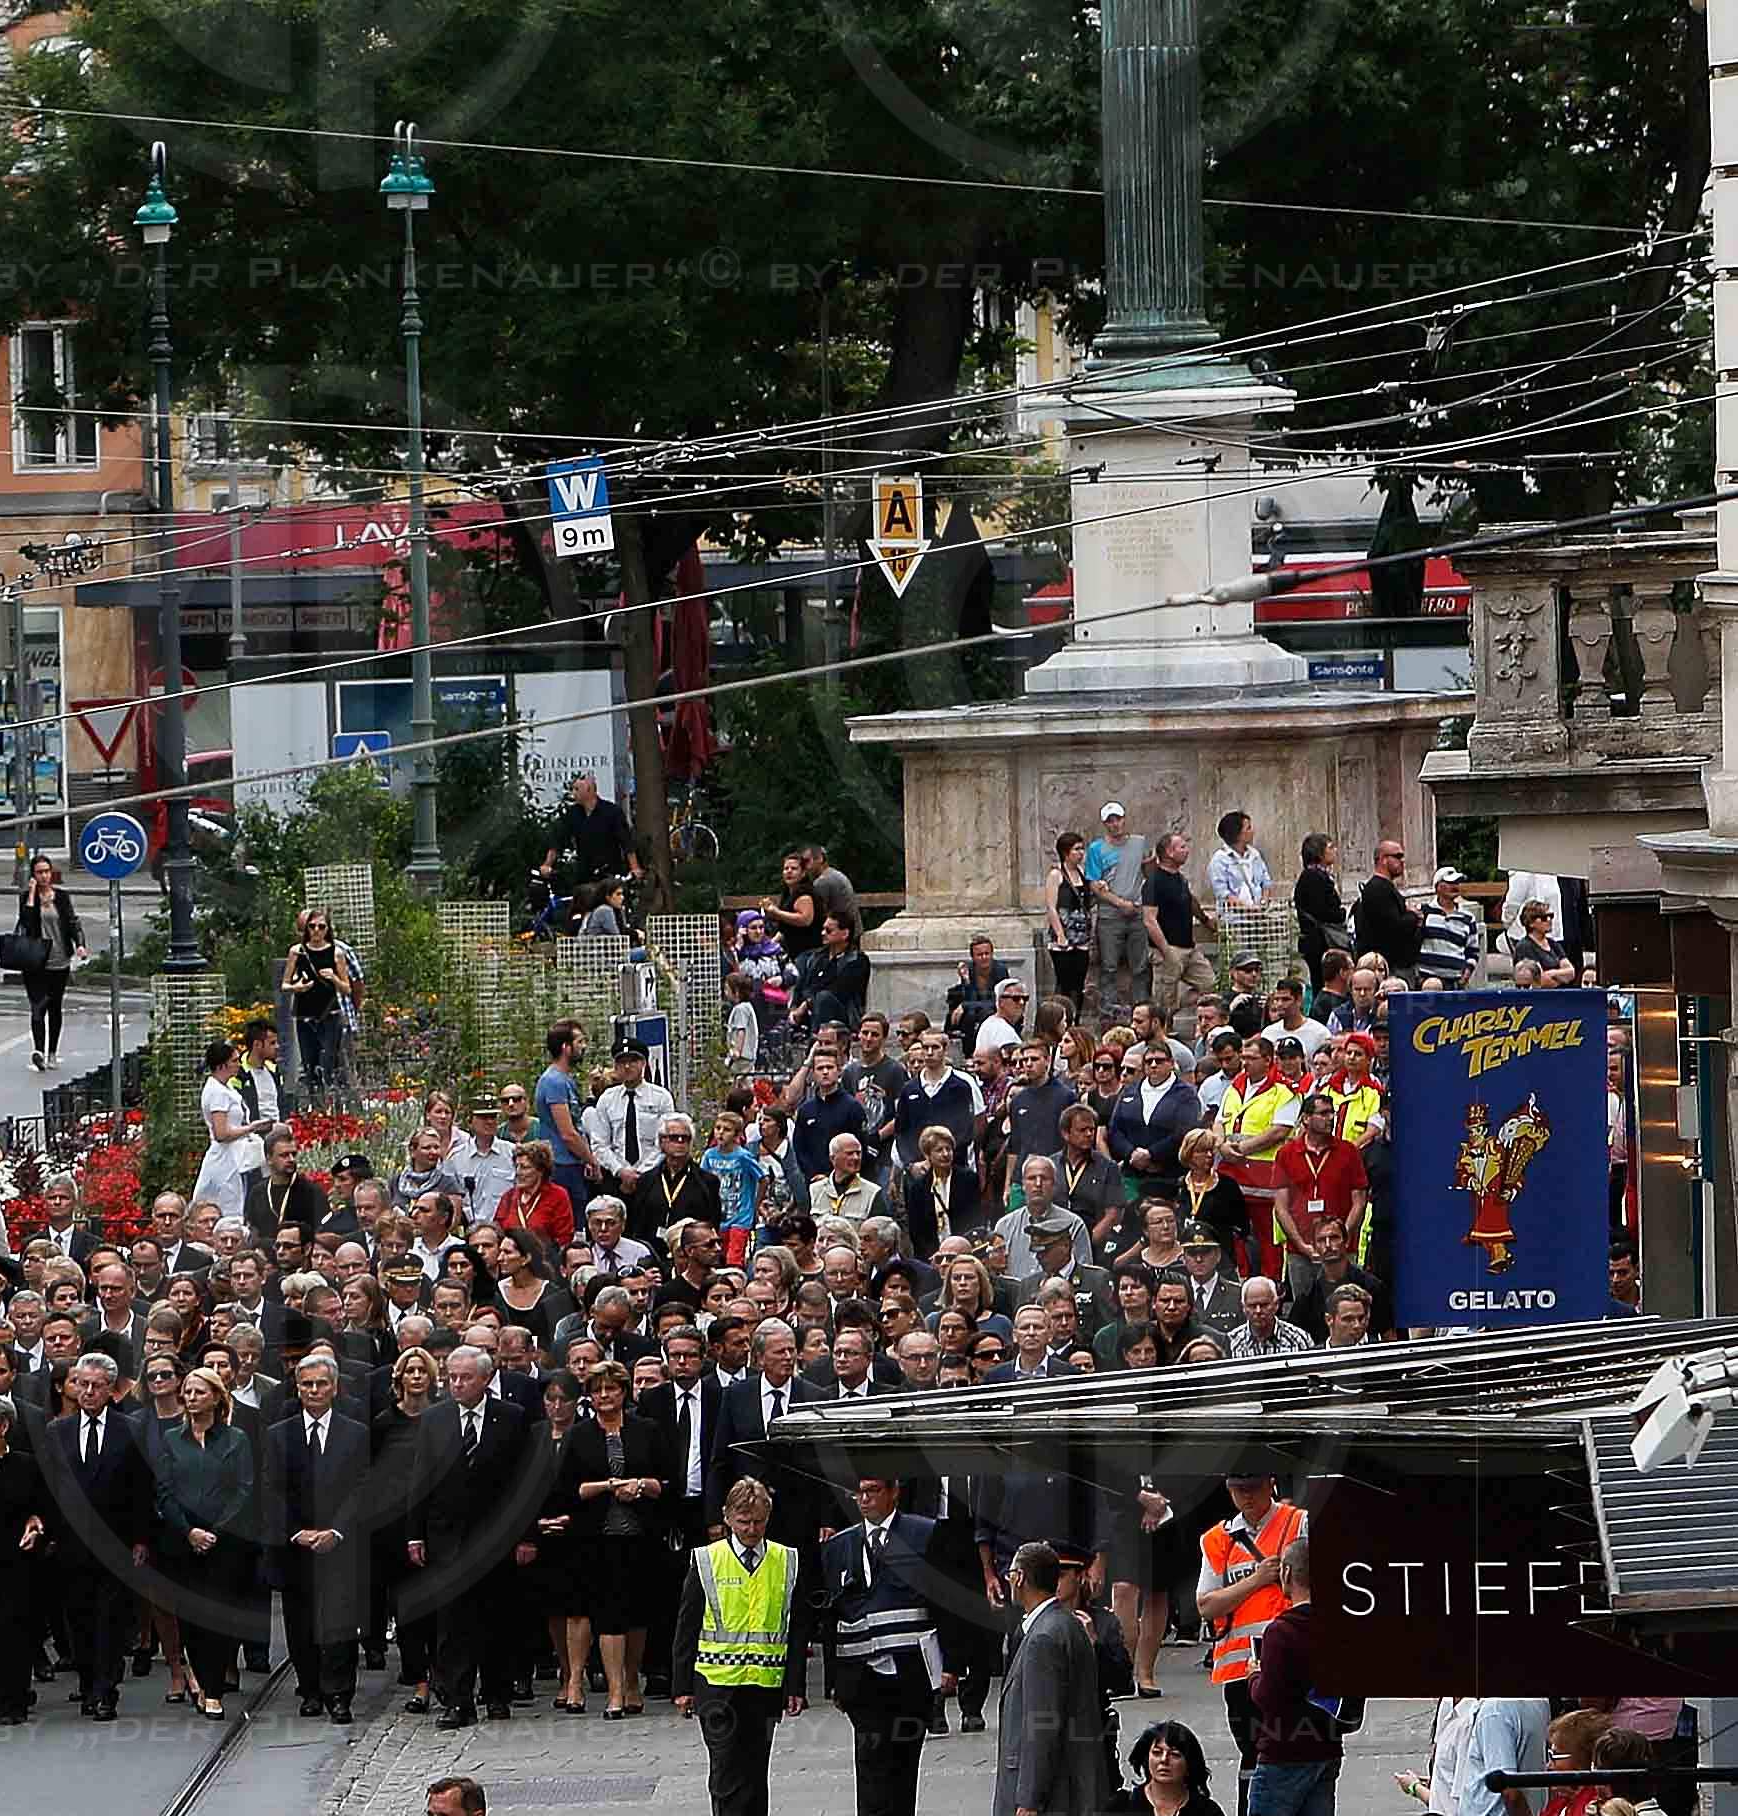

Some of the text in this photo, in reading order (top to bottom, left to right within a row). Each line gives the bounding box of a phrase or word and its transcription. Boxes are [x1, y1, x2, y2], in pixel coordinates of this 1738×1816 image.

[555, 473, 598, 512] W
[883, 489, 914, 534] A
[1412, 1005, 1534, 1055] CHARLY
[1461, 1019, 1583, 1079] TEMMEL
[1448, 1289, 1557, 1311] GELATO
